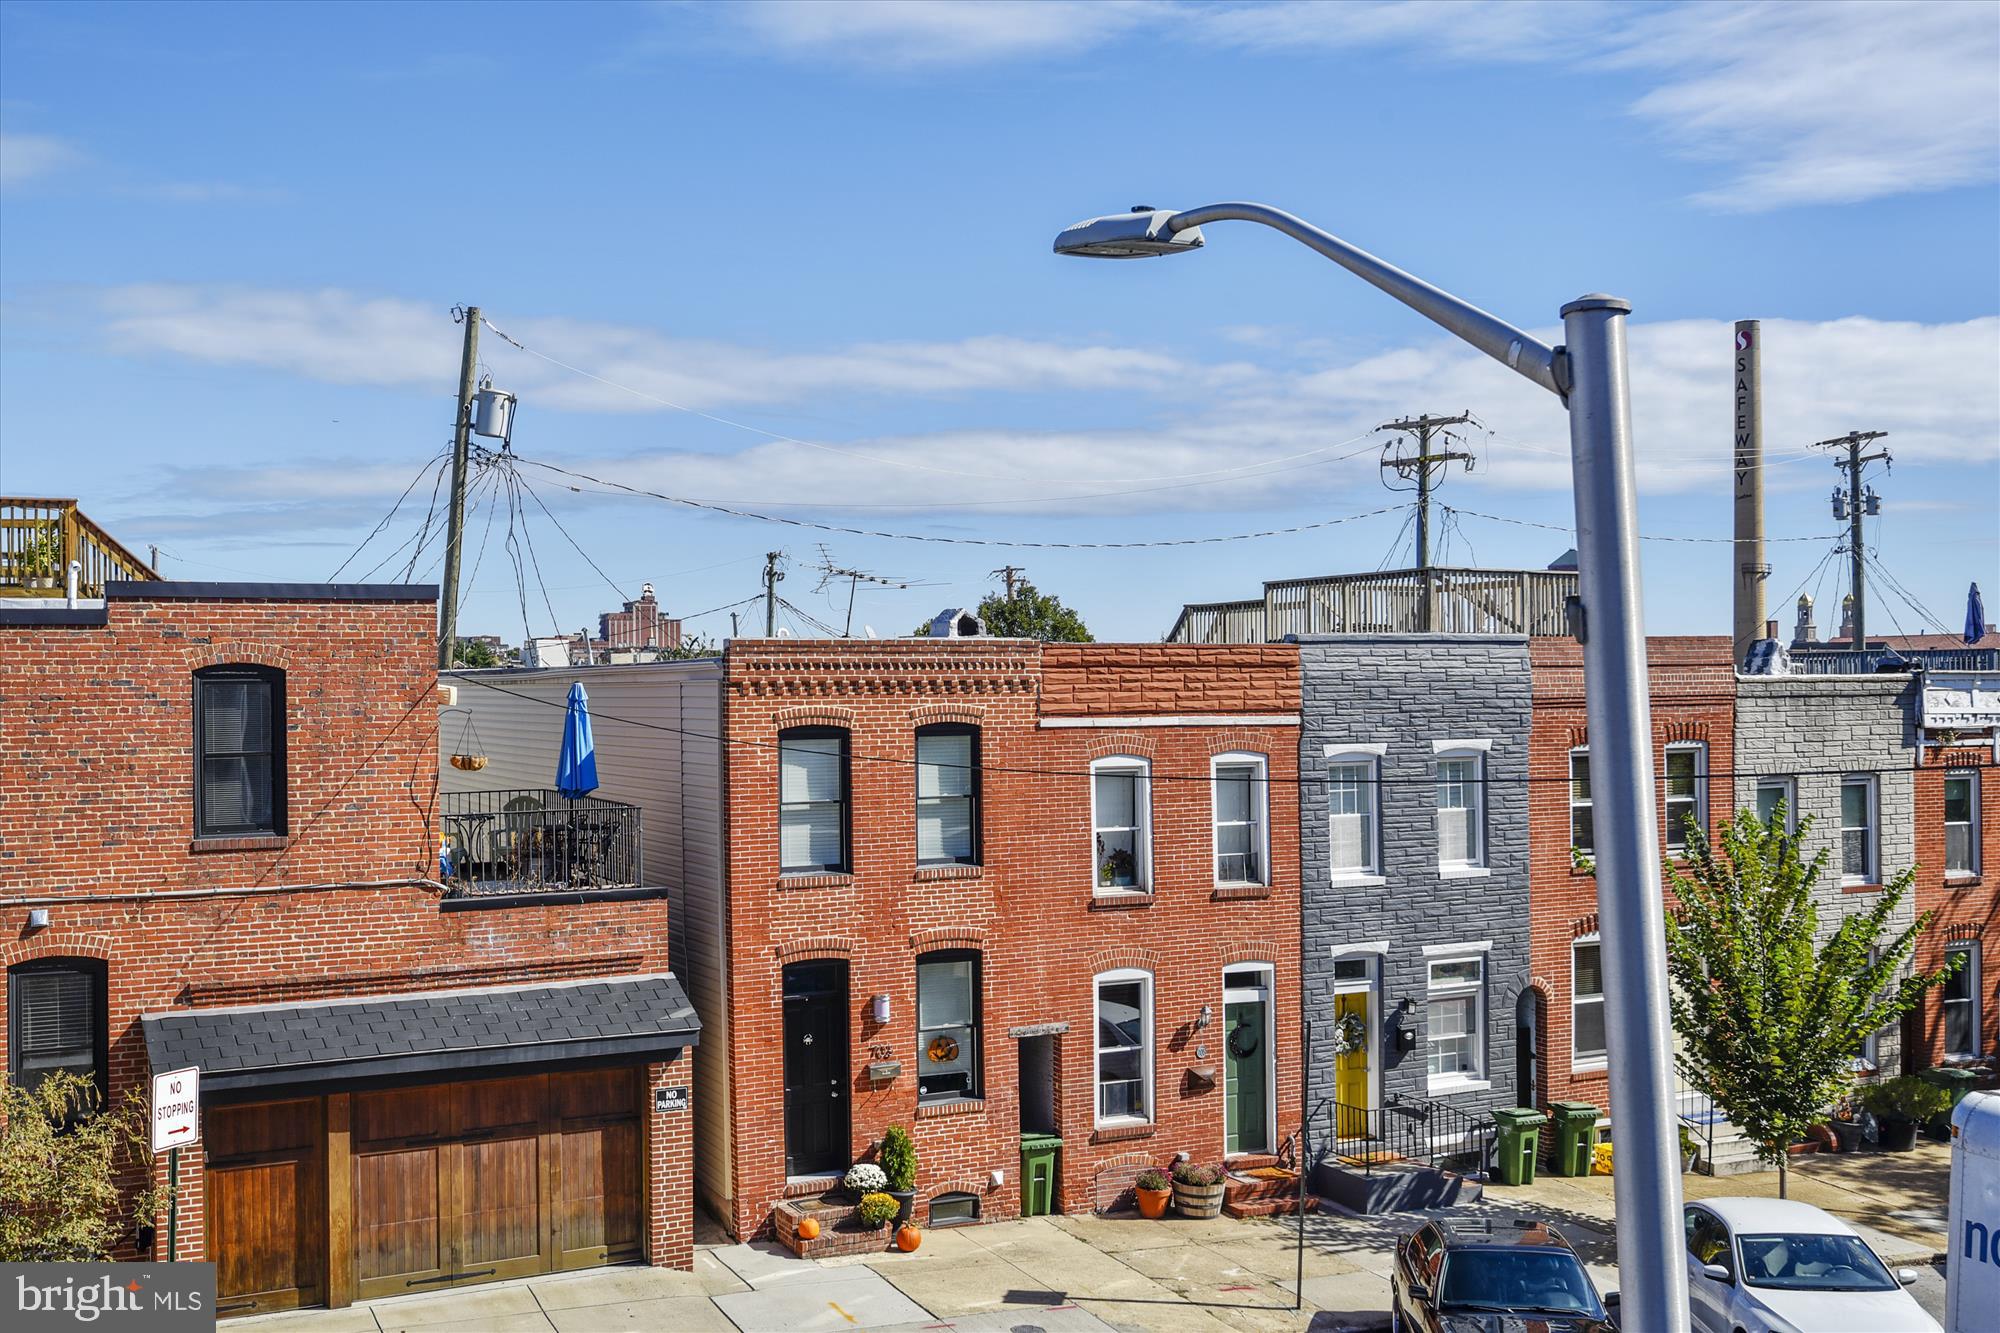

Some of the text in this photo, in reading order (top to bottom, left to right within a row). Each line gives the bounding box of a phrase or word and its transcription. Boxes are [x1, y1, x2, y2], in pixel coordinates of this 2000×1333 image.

[1735, 357, 1750, 486] SAFEWAY
[170, 1081, 182, 1095] NO
[665, 1090, 678, 1100] NO
[157, 1100, 194, 1120] STOPPING
[657, 1098, 686, 1110] PARKING
